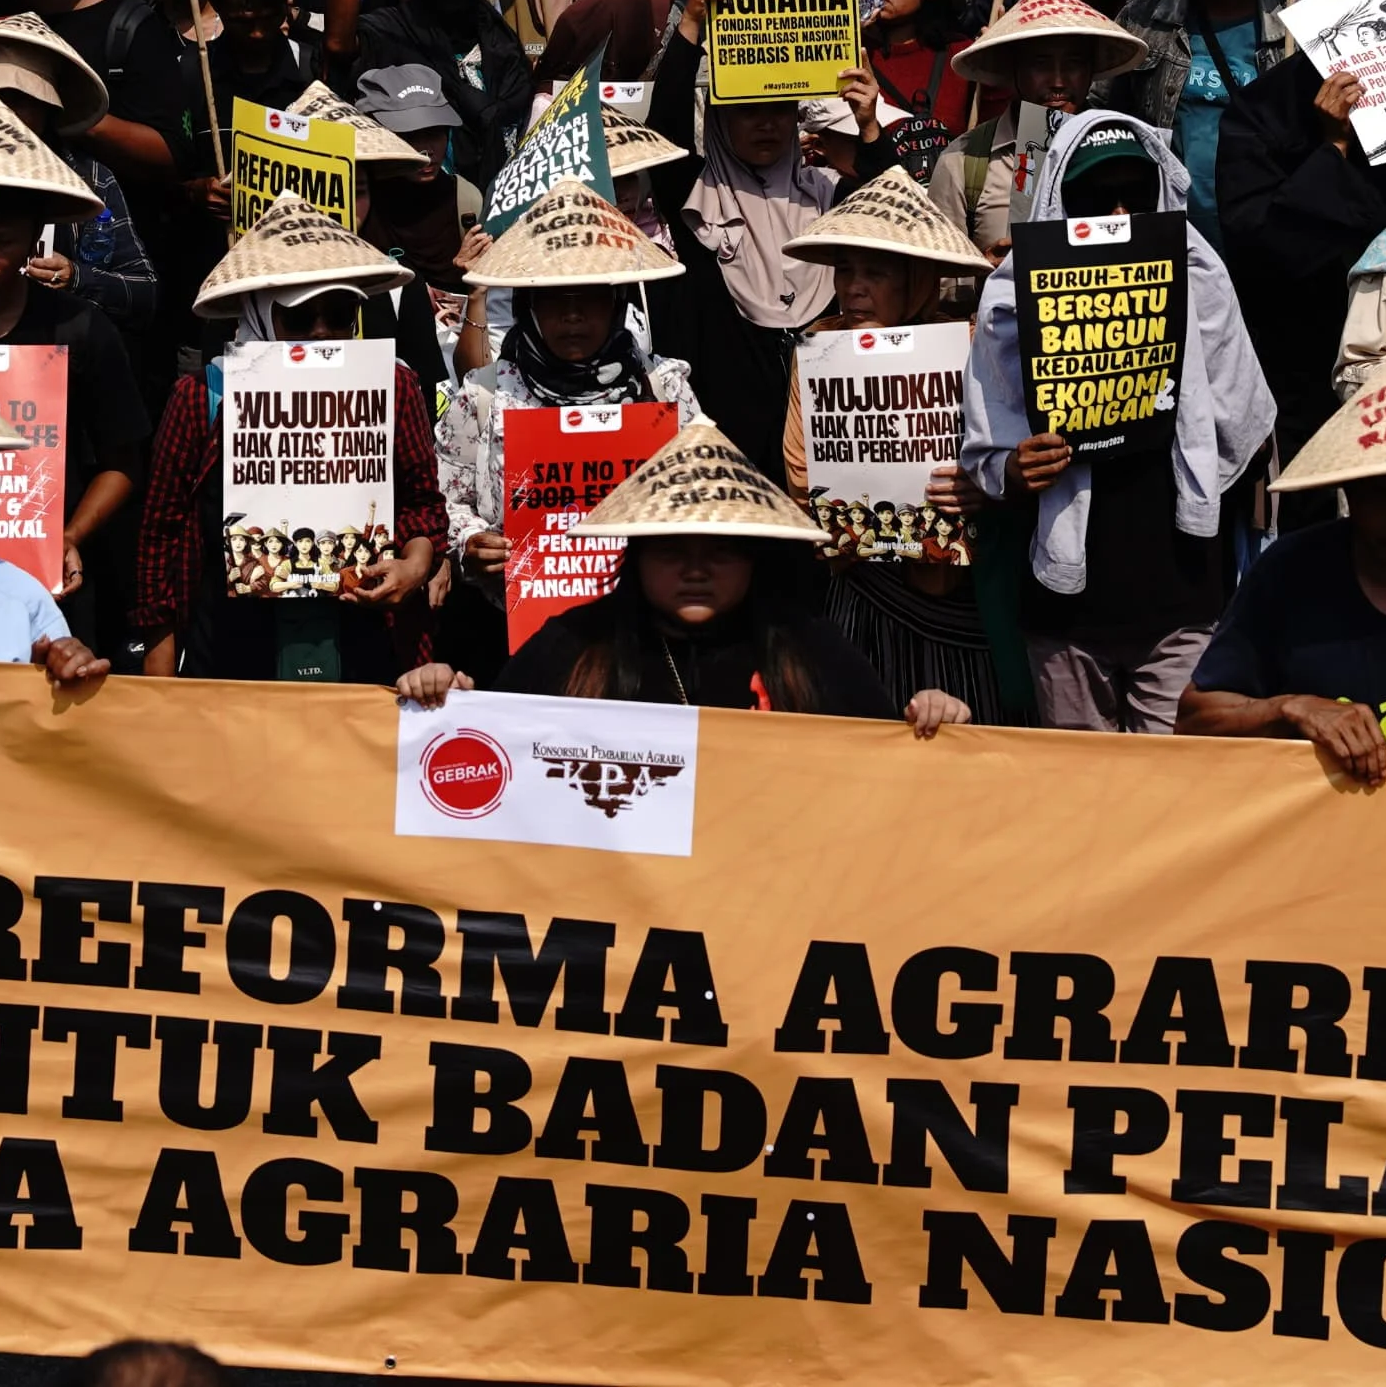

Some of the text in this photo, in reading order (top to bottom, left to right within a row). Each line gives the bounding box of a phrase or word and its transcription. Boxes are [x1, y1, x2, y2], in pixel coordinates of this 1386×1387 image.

[716, 14, 850, 31] FONDASI PEMBANGUNAN
[717, 30, 850, 46] INDUSTRIALISASI NASIONAL
[719, 43, 851, 65] BERBASIS RAKYAT
[763, 81, 809, 91] #MayDay2026
[546, 233, 635, 251] SEJATI
[1036, 263, 1167, 290] BURUH-TANI
[1038, 288, 1168, 323] BERSATU
[1041, 317, 1166, 353] BANGUN
[1036, 345, 1173, 377] KEDAULATAN
[809, 370, 963, 413] WUJUDKAN
[234, 390, 387, 429] WUJUDKAN
[1048, 395, 1157, 435] PANGAN
[811, 411, 965, 440] HAK ATAS TANAH
[232, 430, 387, 458] HAK ATAS TANAH
[813, 440, 854, 464] BAGI
[1079, 436, 1125, 452] #MayDay2026
[232, 457, 387, 485] BAGI PEREMPUAN
[582, 461, 613, 481] NO
[544, 555, 619, 575] RAKYAT
[433, 762, 498, 784] GEBRAK
[425, 1041, 1018, 1193] BADAN
[129, 1147, 872, 1305] AGRARIA
